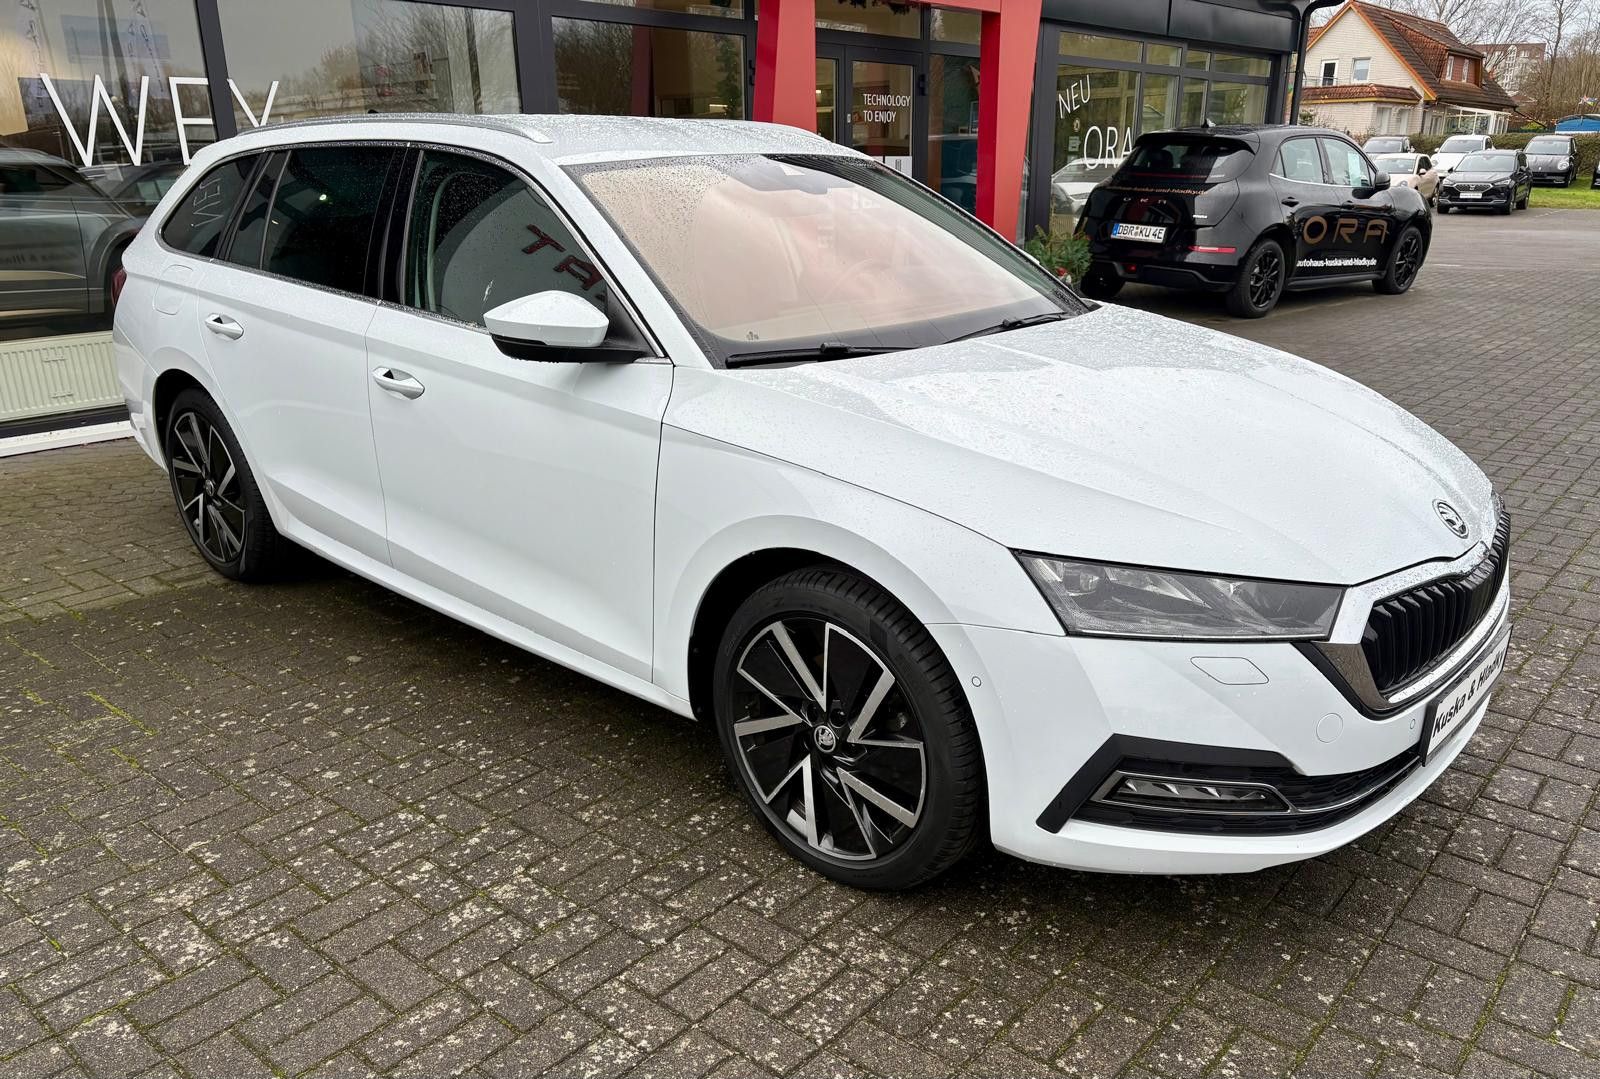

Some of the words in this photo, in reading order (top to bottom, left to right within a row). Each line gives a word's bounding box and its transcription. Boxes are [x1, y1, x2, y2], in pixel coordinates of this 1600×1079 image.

[863, 94, 911, 107] TECHNOLOGY
[1058, 74, 1091, 119] NEU
[863, 110, 873, 122] TO
[875, 111, 897, 124] ENJOY
[1083, 125, 1134, 170] ORA
[1118, 225, 1135, 237] DBR
[1140, 226, 1151, 237] KU
[1152, 228, 1164, 239] 4E
[1303, 215, 1388, 245] ORA
[1432, 693, 1467, 738] Kuska
[1468, 680, 1476, 701] &
